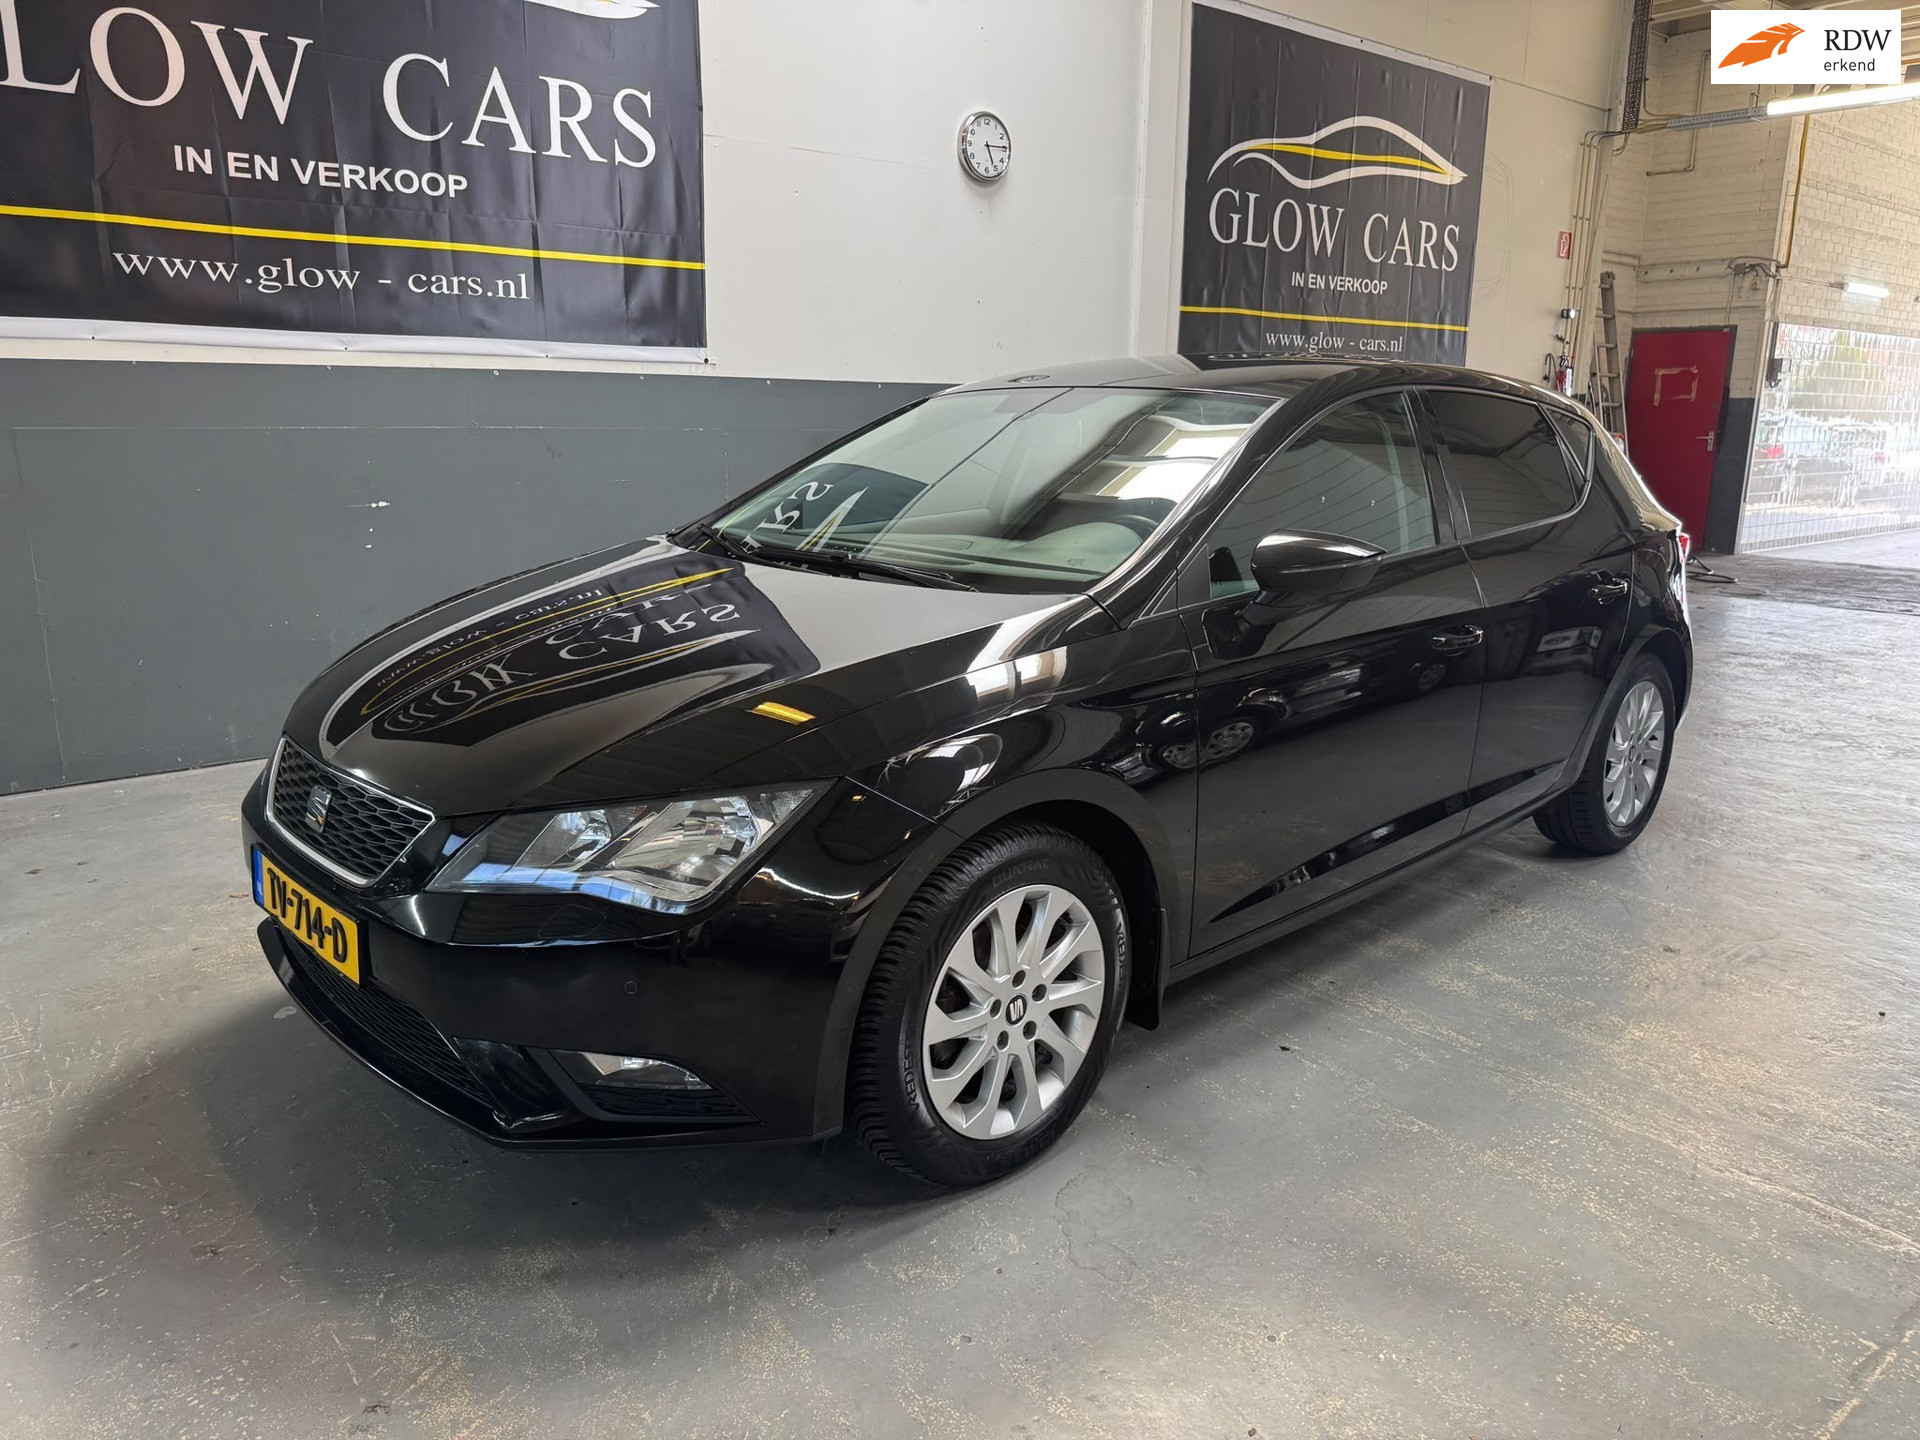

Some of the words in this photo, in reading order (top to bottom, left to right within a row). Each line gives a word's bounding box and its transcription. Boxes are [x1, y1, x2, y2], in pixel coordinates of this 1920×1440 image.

[382, 52, 657, 169] CARS
[999, 132, 1005, 140] 2
[173, 144, 214, 176] IN
[227, 152, 281, 183] EN
[291, 158, 469, 199] VERKOOP
[1208, 187, 1346, 259] GLOW
[1363, 212, 1461, 273] CARS
[112, 250, 361, 296] www.glow
[407, 268, 531, 301] cars.nl
[1291, 271, 1305, 288] IN
[1308, 273, 1326, 290] EN
[1328, 275, 1389, 296] VERKOOP
[1265, 331, 1346, 353] www.glow
[1359, 335, 1404, 353] cars.nl
[266, 867, 348, 964] TV-714-D
